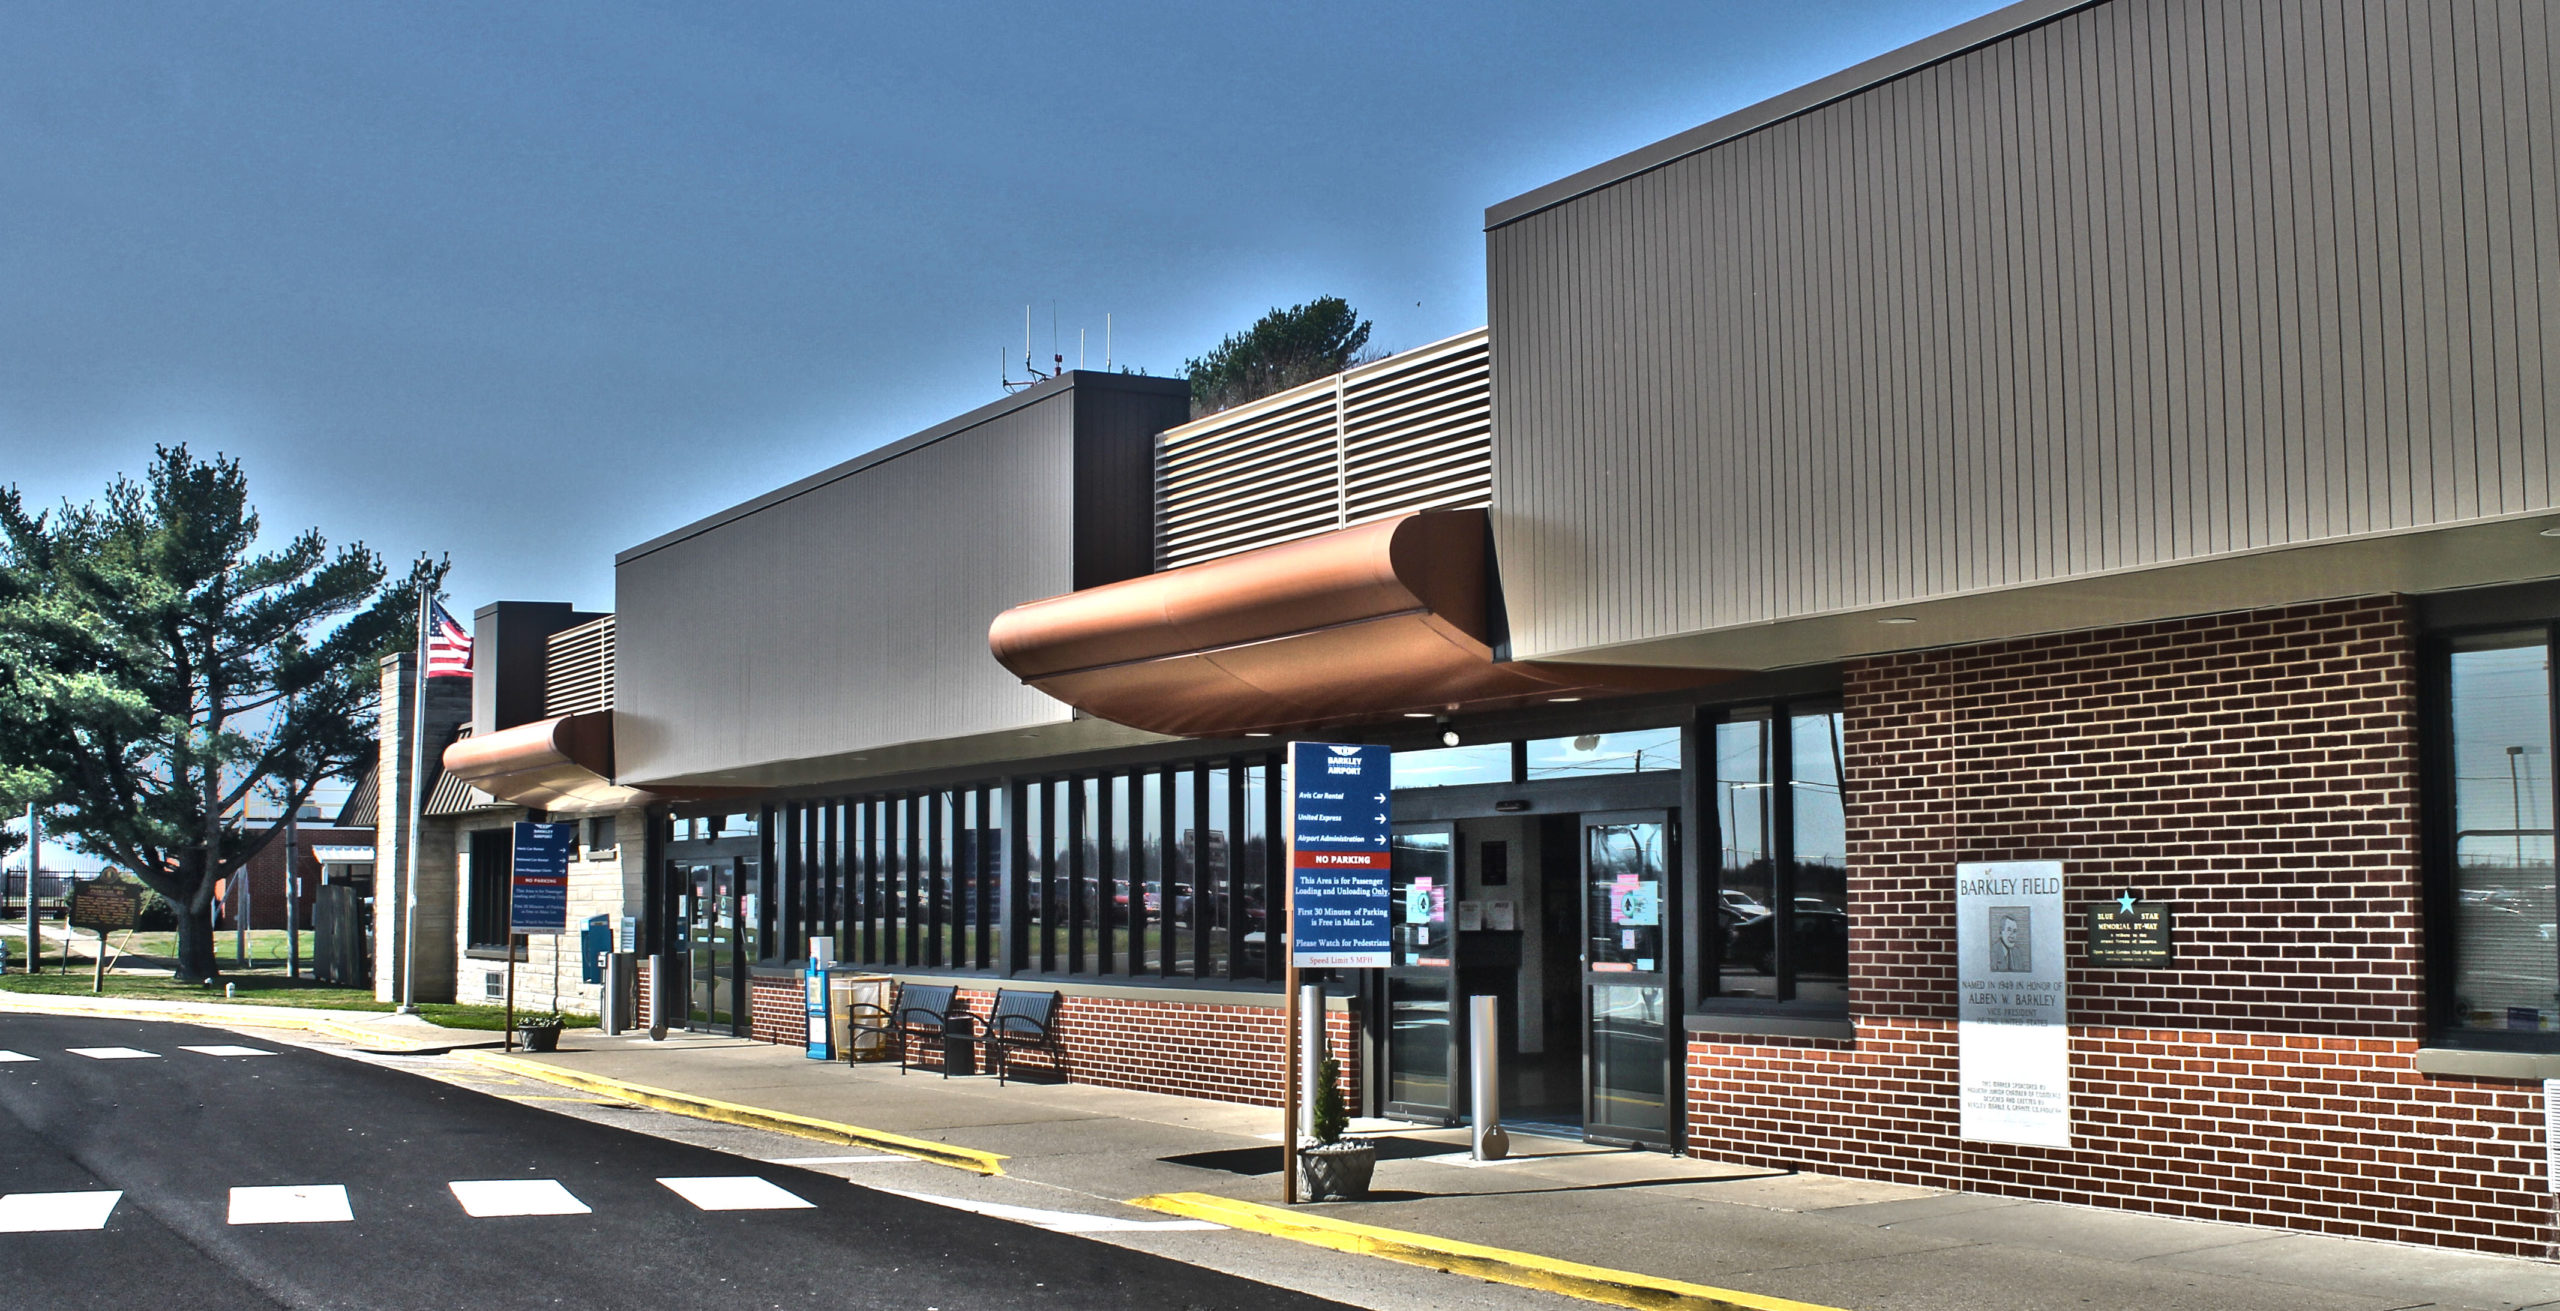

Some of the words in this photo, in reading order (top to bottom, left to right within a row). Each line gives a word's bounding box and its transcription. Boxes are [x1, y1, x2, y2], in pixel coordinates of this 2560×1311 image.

[1328, 757, 1362, 765] BARKLEY
[1328, 767, 1361, 775] AIRPORT
[1319, 815, 1342, 823] Express
[1298, 835, 1320, 843] Airport
[1320, 835, 1365, 843] Administration
[1331, 856, 1371, 864] PARKING
[1300, 876, 1315, 885] This
[1317, 877, 1332, 885] Area
[1334, 877, 1339, 885] is
[1341, 877, 1350, 885] for
[1352, 877, 1384, 887] Passenger
[1960, 878, 2018, 896] BARKLEY
[2022, 877, 2060, 895] FIELD
[1295, 887, 1322, 896] Loading
[1323, 887, 1335, 895] and
[1337, 887, 1370, 897] Unloading
[1298, 908, 1313, 916] First
[1315, 908, 1323, 916] 30
[1324, 908, 1351, 916] Minutes
[1354, 908, 1362, 916] of
[1363, 908, 1388, 918] Parking
[2097, 912, 2114, 920] BLUE
[2141, 912, 2159, 920] STAR
[1311, 919, 1317, 927] is
[1319, 919, 1333, 927] Free
[1335, 919, 1342, 927] in
[1343, 919, 1360, 927] Main
[1362, 919, 1375, 927] Lot.
[2134, 922, 2158, 930] BY-WAY
[1296, 939, 1317, 948] Please
[1319, 939, 1340, 948] Watch
[1342, 939, 1352, 948] for
[1353, 940, 1390, 948] Pedestrians
[1310, 957, 1329, 966] Speed
[1331, 956, 1349, 965] Limit
[1357, 957, 1373, 965] MPH
[1962, 980, 1985, 990] NAMED
[1987, 981, 1996, 990] IN
[1998, 981, 2013, 990] 1949
[2015, 982, 2024, 990] IN
[2026, 981, 2051, 991] HONOR
[2053, 981, 2063, 991] OF
[1968, 993, 1997, 1005] ALBEN
[2015, 993, 2057, 1007] BARKLEY
[1987, 1008, 2001, 1016] VICE
[2004, 1008, 2037, 1017] PRESIDENT
[2026, 1018, 2048, 1027] STATES
